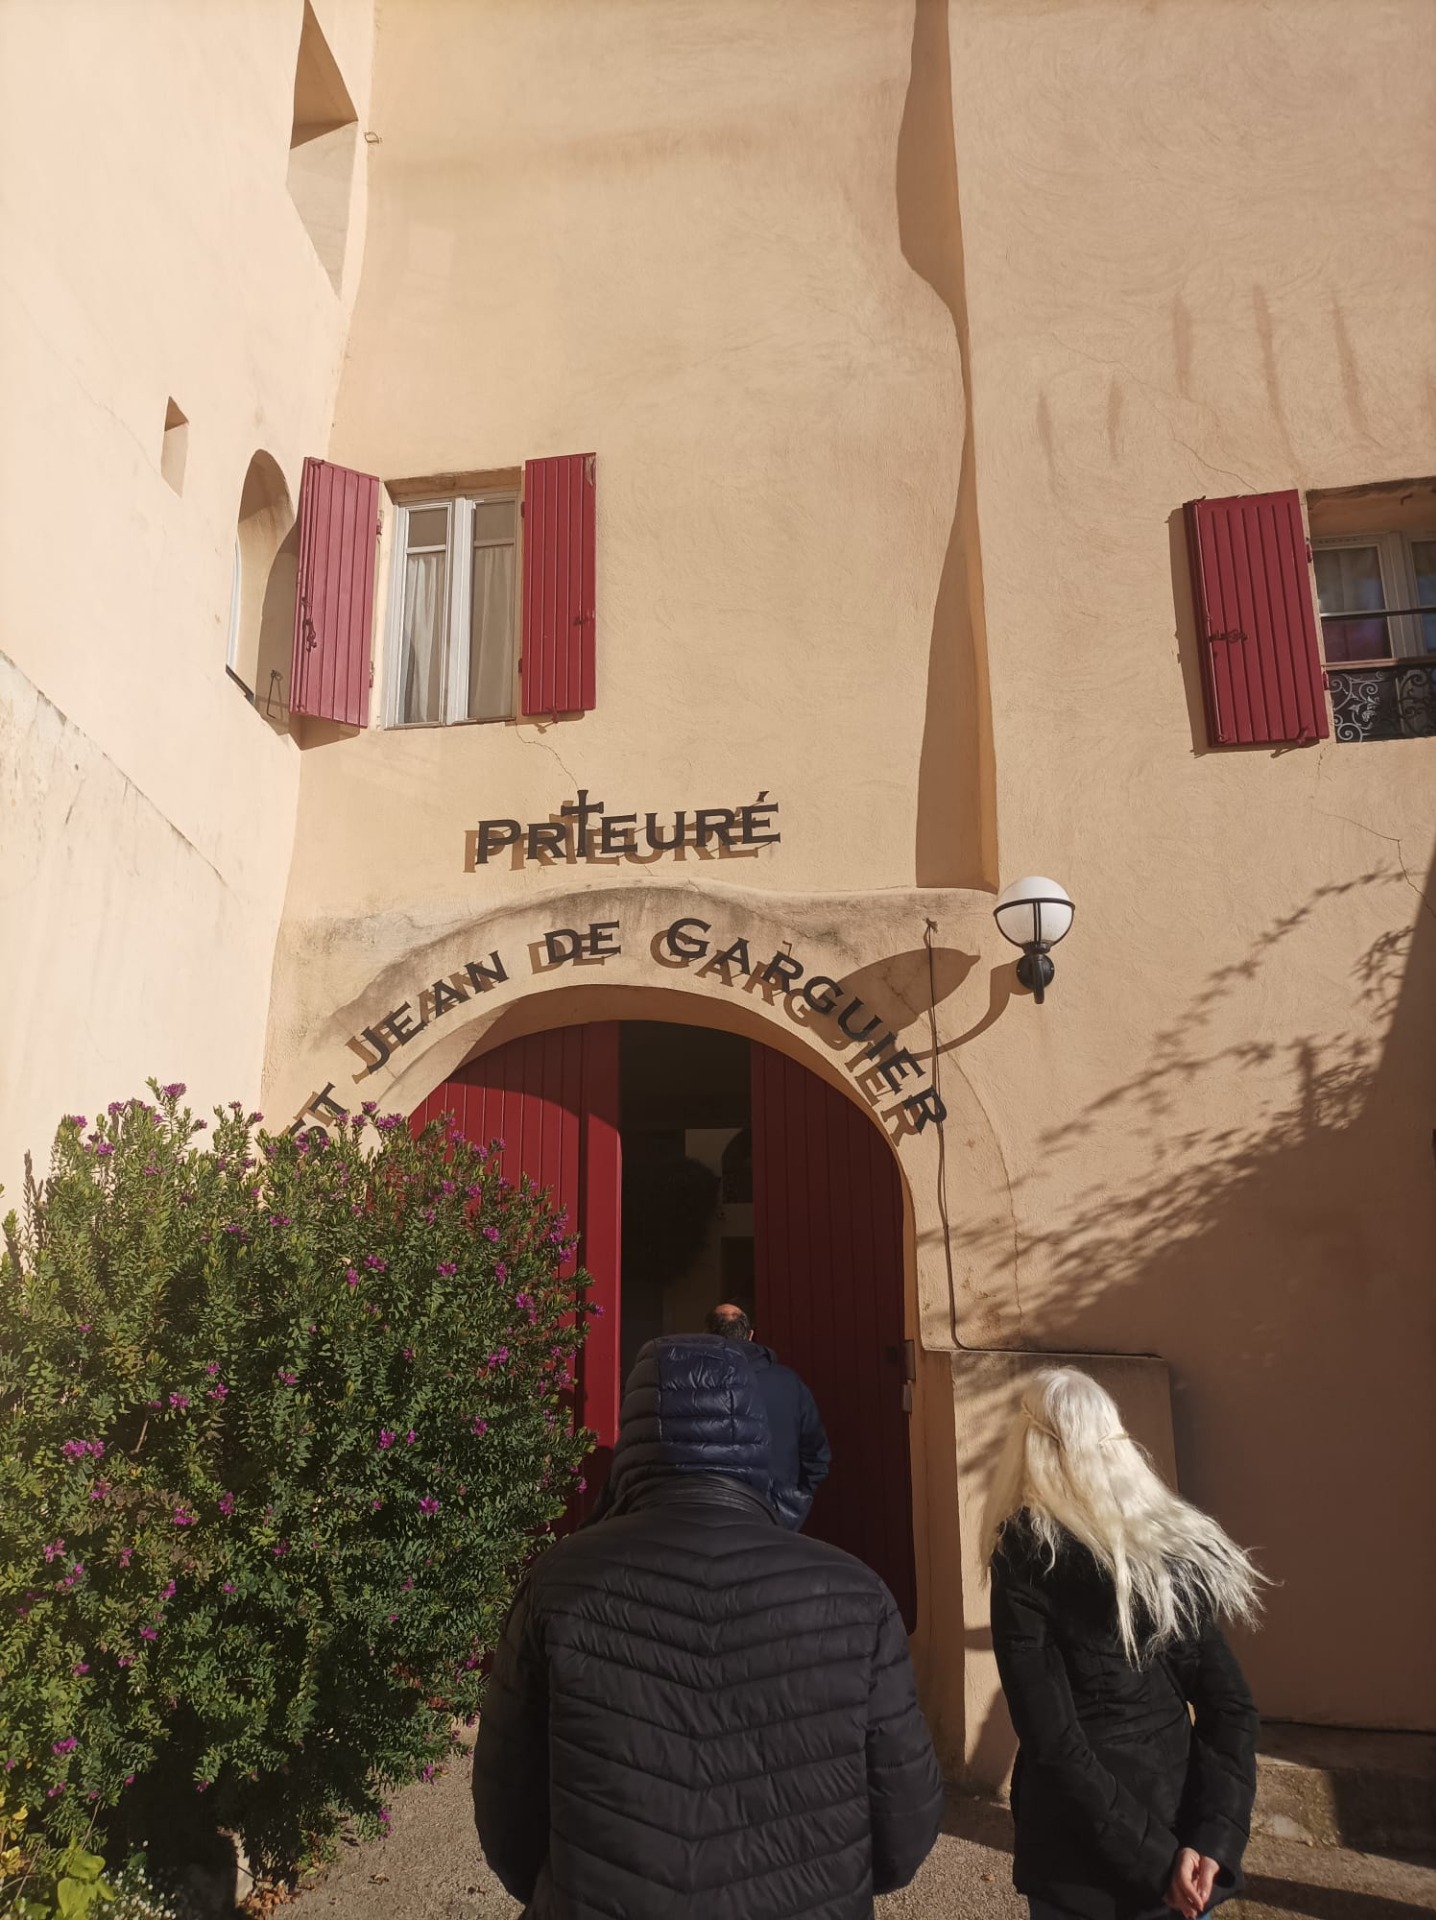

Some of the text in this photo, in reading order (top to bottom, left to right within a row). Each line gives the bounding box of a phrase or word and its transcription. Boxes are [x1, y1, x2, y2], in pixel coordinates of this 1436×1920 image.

[360, 950, 509, 1074] JEAN
[543, 920, 622, 965] DE
[666, 917, 948, 1135] GARGUIER
